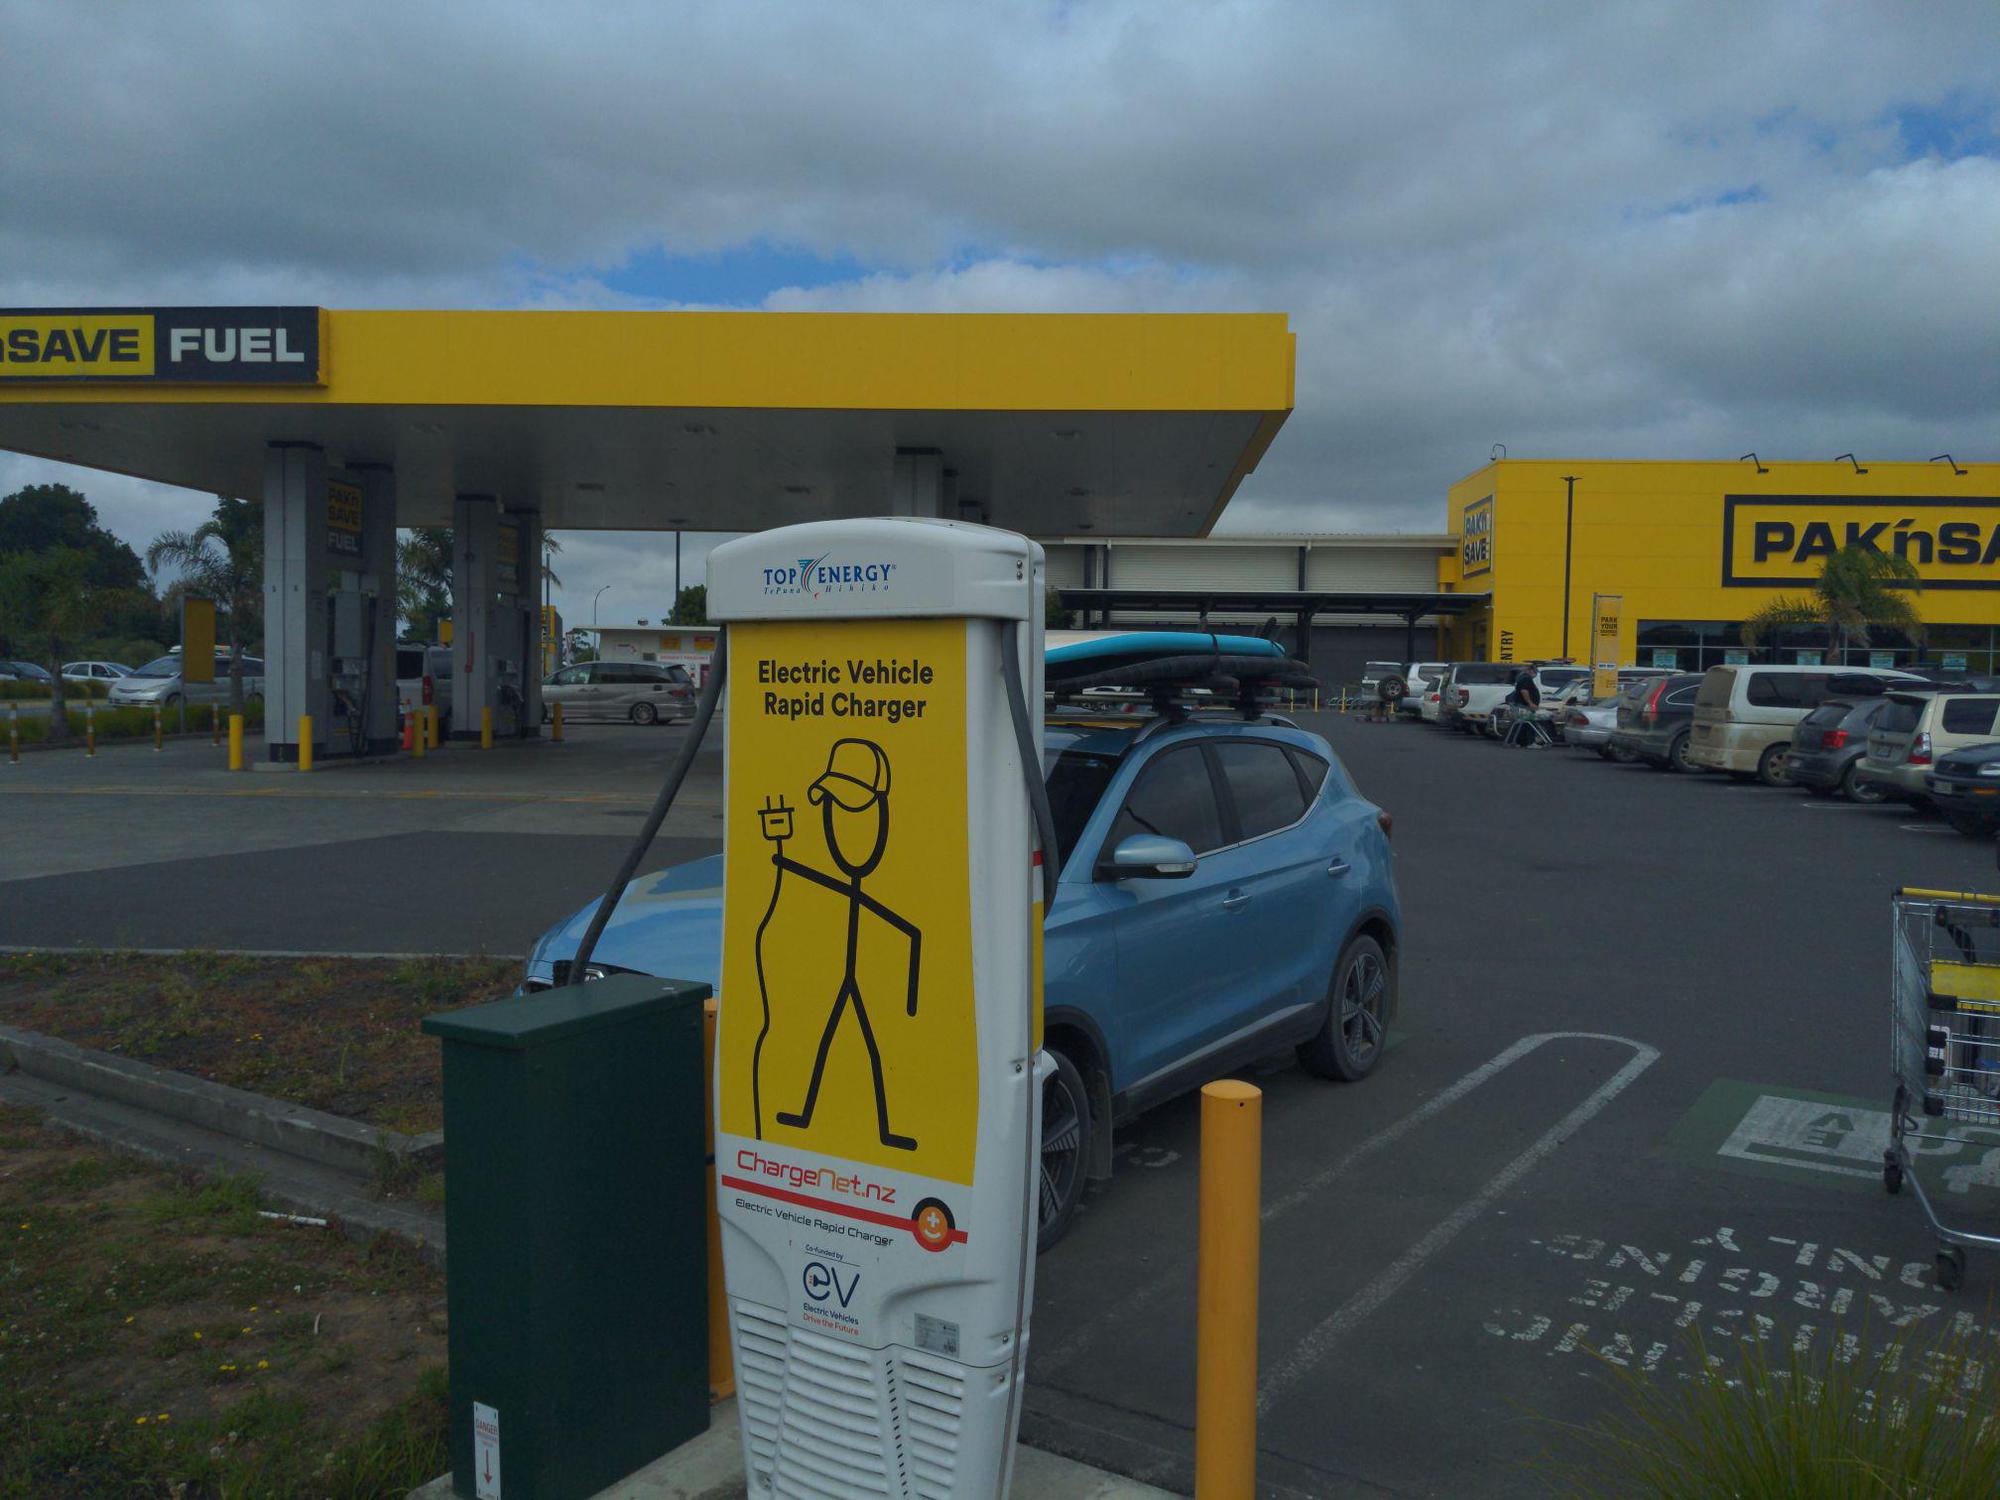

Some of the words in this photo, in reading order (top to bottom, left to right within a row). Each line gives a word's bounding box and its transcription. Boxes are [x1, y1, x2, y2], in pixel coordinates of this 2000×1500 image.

[0, 328, 139, 364] SAVE
[169, 327, 305, 363] FUEL
[327, 505, 360, 526] SAVE
[327, 532, 358, 551] FUEL
[1464, 536, 1488, 565] SAVE
[763, 567, 797, 586] TOP
[818, 563, 891, 584] ENERGY
[1501, 630, 1513, 663] NTRY
[758, 660, 841, 684] Electric
[847, 659, 934, 685] Vehicle
[764, 692, 825, 721] Rapid
[831, 692, 927, 724] Charger
[735, 1198, 773, 1216] Electric
[775, 1207, 812, 1226] Vehicle
[813, 1217, 845, 1238] Rapid
[847, 1226, 895, 1247] Charger
[805, 1243, 835, 1258] Co-funded
[834, 1251, 844, 1261] by
[803, 1302, 829, 1317] Electric
[829, 1309, 860, 1326] Vehicles
[803, 1312, 822, 1326] Drive
[821, 1318, 834, 1329] the
[834, 1321, 860, 1336] Future
[475, 1418, 498, 1435] DANGER
